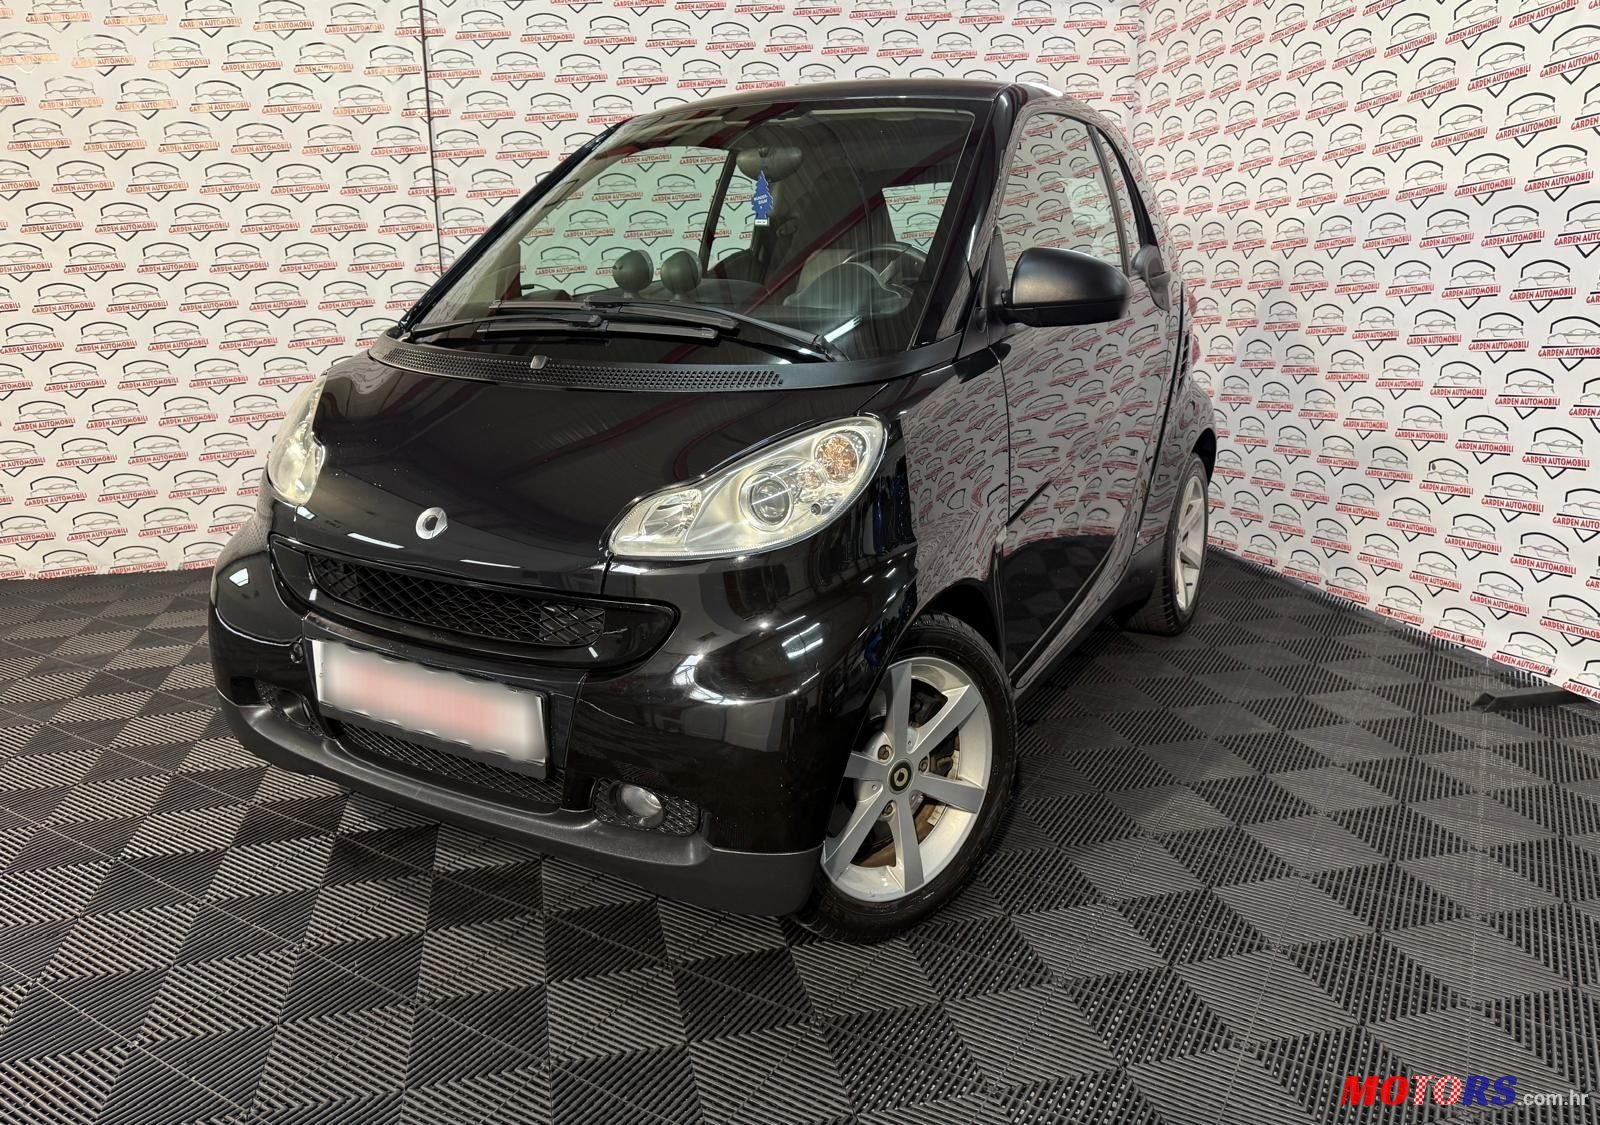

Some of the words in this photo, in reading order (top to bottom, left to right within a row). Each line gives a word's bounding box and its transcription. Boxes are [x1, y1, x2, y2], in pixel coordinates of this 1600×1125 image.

[1509, 12, 1535, 28] GARDEN
[1536, 0, 1579, 18] AUTOMOBILI
[1443, 30, 1465, 44] GARDEN
[1466, 15, 1503, 36] AUTOMOBILI
[1384, 45, 1404, 58] GARDEN
[1405, 31, 1437, 50] AUTOMOBILI
[1468, 77, 1491, 91] GARDEN
[1492, 64, 1531, 83] AUTOMOBILI
[1539, 63, 1566, 78] GARDEN
[1405, 90, 1425, 102] GARDEN
[1426, 78, 1460, 95] AUTOMOBILI
[1495, 127, 1519, 140] GARDEN
[1520, 115, 1562, 133] AUTOMOBILI
[1570, 116, 1599, 130] GARDEN
[1430, 136, 1451, 148] GARDEN
[1452, 126, 1488, 142] AUTOMOBILI
[1455, 185, 1477, 196] GARDEN
[1478, 177, 1516, 191] AUTOMOBILI
[1523, 179, 1549, 191] GARDEN
[1551, 170, 1594, 186] AUTOMOBILI
[1394, 191, 1414, 201] GARDEN
[1415, 183, 1448, 196] AUTOMOBILI
[1418, 238, 1439, 248] GARDEN
[1440, 232, 1474, 244] AUTOMOBILI
[1480, 237, 1504, 247] GARDEN
[1505, 230, 1545, 243] AUTOMOBILI
[1441, 289, 1463, 297] GARDEN
[1464, 285, 1501, 295] AUTOMOBILI
[1508, 291, 1533, 300] GARDEN
[1534, 287, 1577, 298] AUTOMOBILI
[1428, 335, 1461, 343] AUTOMOBILI
[1491, 340, 1530, 349] AUTOMOBILI
[1519, 398, 1560, 406] AUTOMOBILI
[1415, 432, 1448, 440] AUTOMOBILI
[1454, 442, 1477, 450] GARDEN
[1478, 443, 1515, 452] AUTOMOBILI
[1521, 455, 1547, 463] GARDEN
[1548, 457, 1591, 467] AUTOMOBILI
[1418, 482, 1439, 491] GARDEN
[1439, 485, 1473, 495] AUTOMOBILI
[1480, 498, 1504, 507] GARDEN
[1505, 501, 1544, 512] AUTOMOBILI
[1552, 516, 1579, 526] GARDEN
[1443, 537, 1465, 546] GARDEN
[1466, 541, 1502, 553] AUTOMOBILI
[1510, 556, 1534, 567] GARDEN
[1535, 561, 1576, 575] AUTOMOBILI
[1409, 572, 1429, 582] GARDEN
[1430, 577, 1463, 590] AUTOMOBILI
[1469, 594, 1492, 605] GARDEN
[1493, 599, 1531, 614] AUTOMOBILI
[1539, 618, 1564, 630] GARDEN
